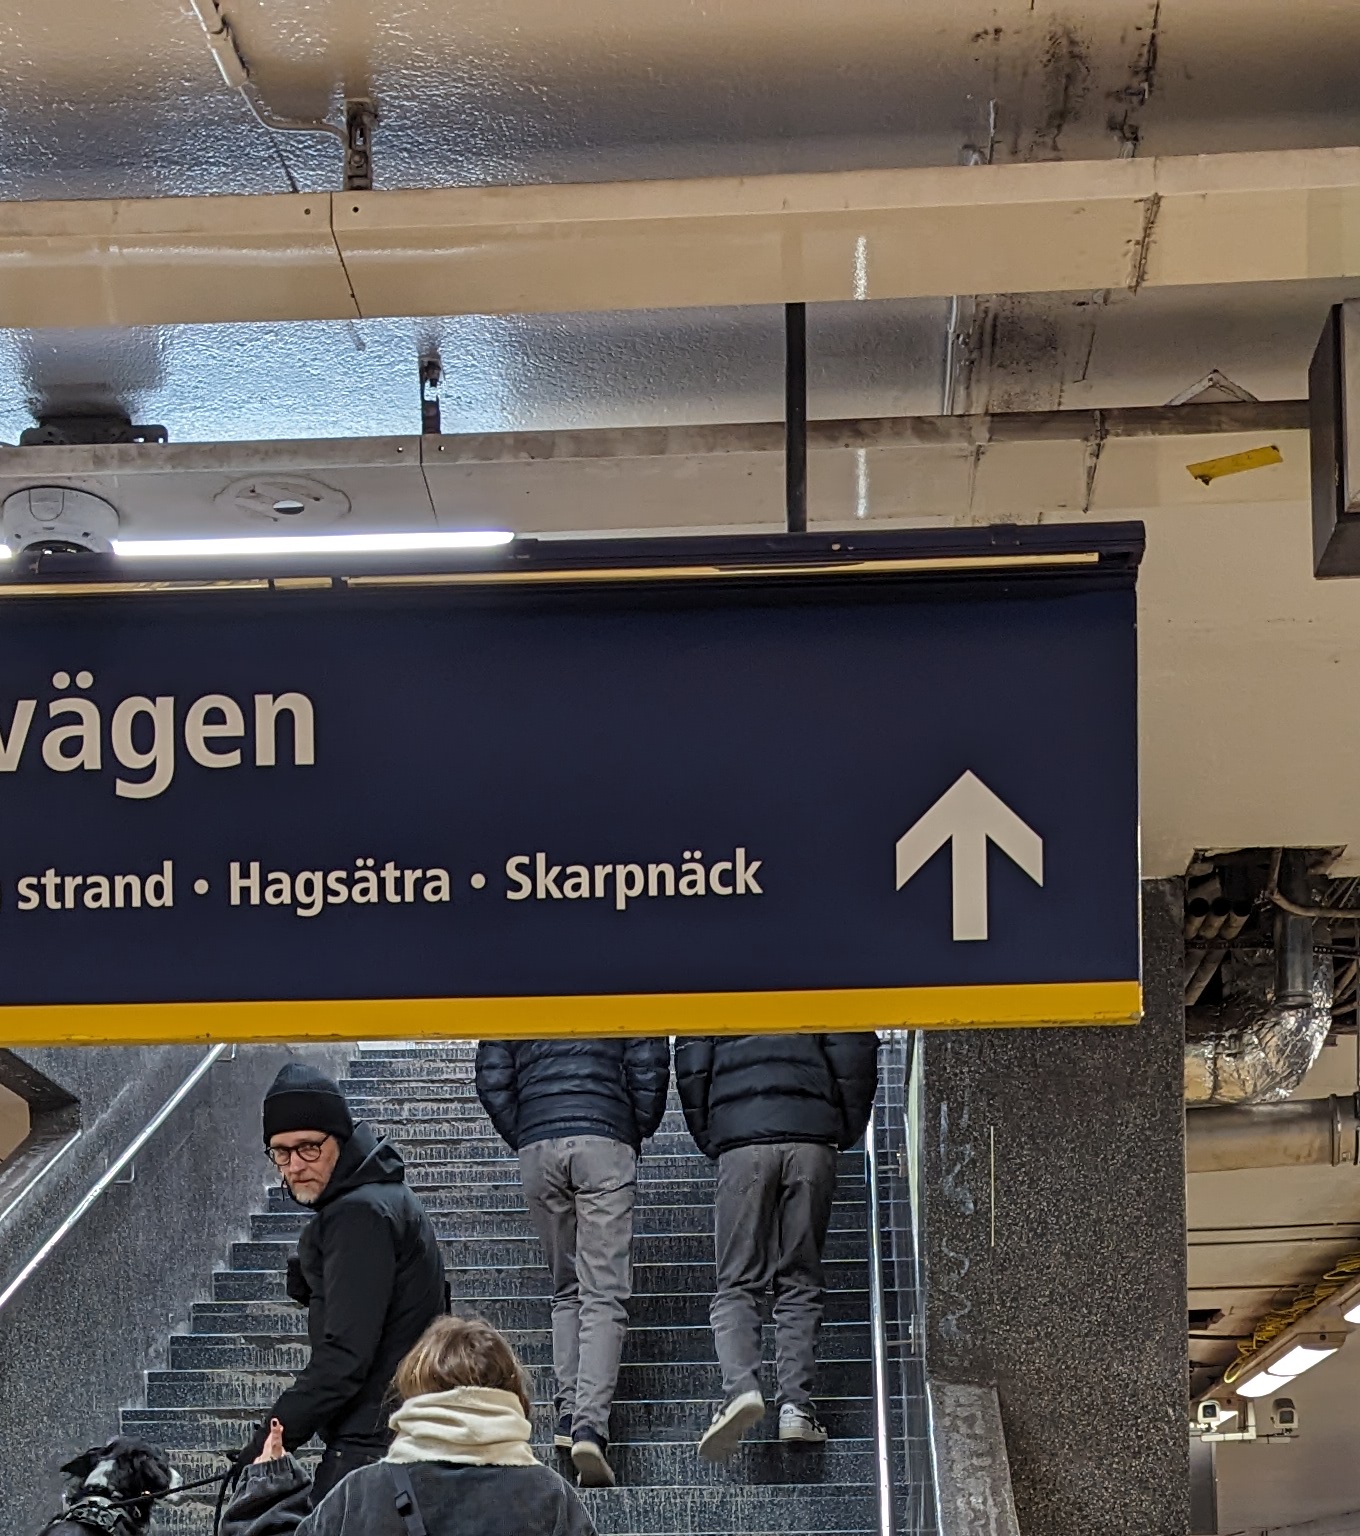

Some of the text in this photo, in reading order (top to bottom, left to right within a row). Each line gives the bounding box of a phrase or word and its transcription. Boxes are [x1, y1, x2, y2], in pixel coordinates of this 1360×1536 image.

[17, 860, 174, 910] strand
[230, 857, 451, 917] Hagsätra
[505, 847, 763, 910] Skarpnäck
